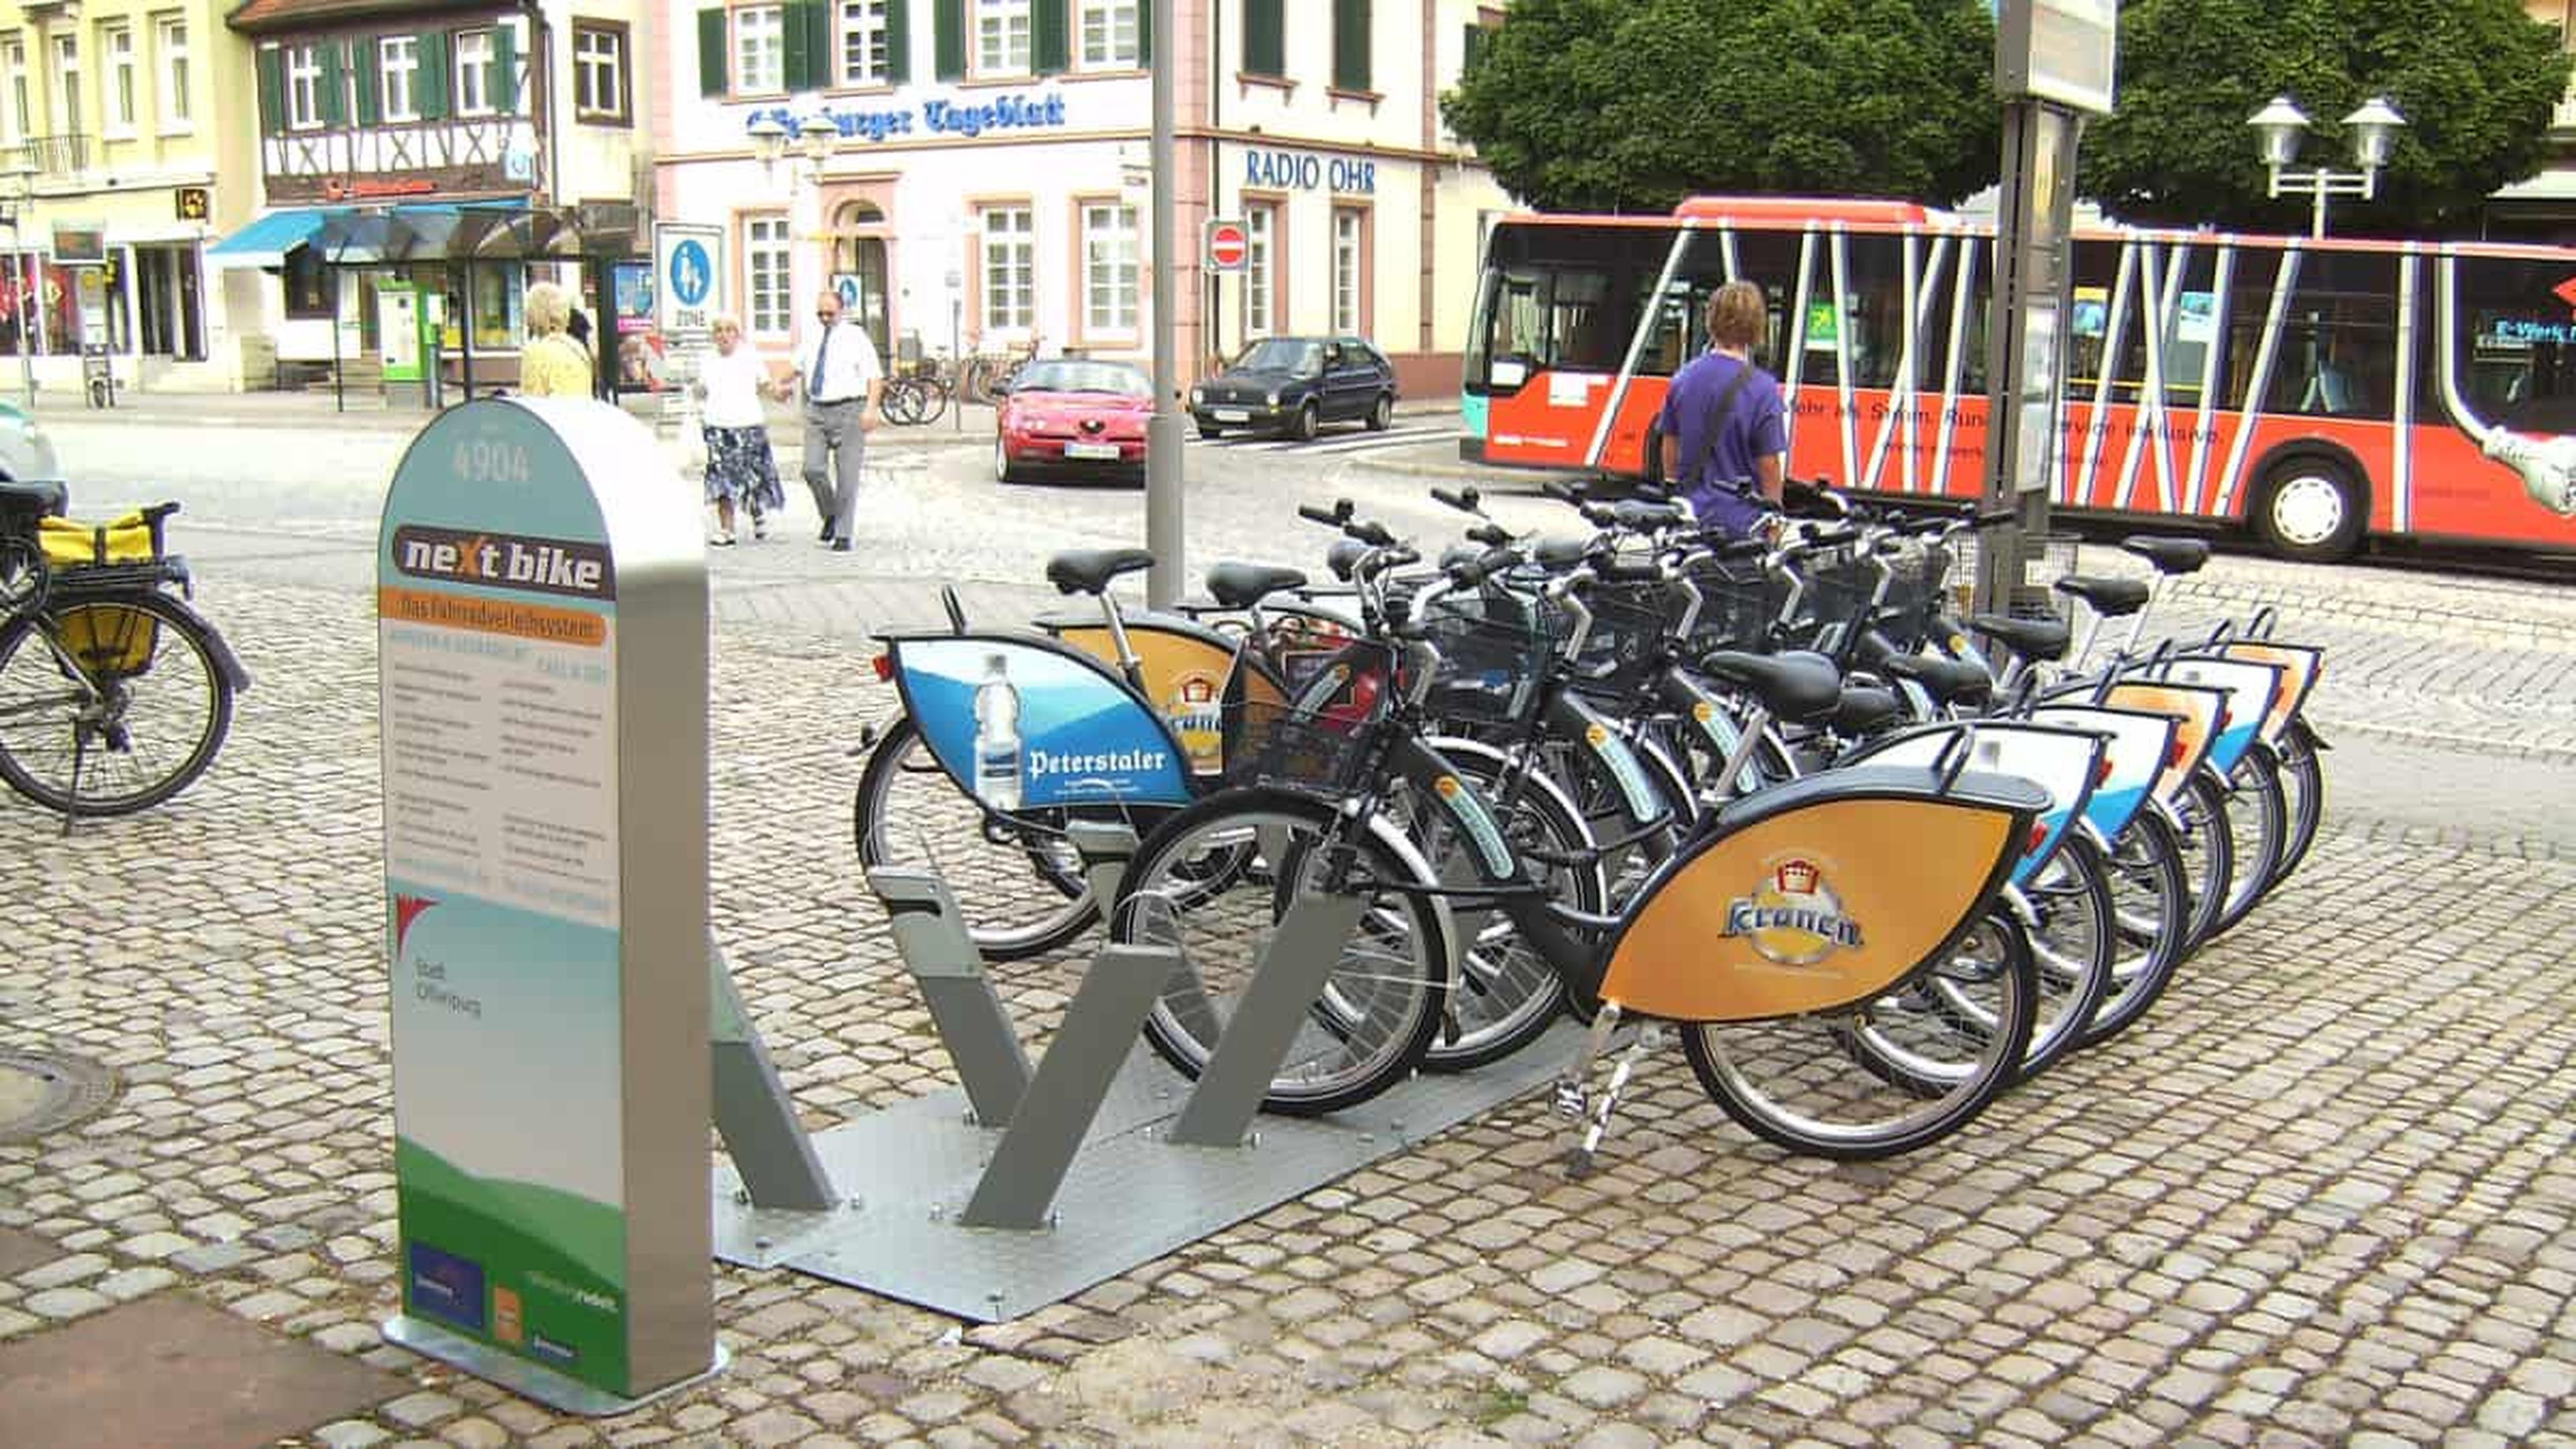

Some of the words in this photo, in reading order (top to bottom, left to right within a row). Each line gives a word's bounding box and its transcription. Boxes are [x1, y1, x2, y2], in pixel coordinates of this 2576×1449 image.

[924, 94, 1066, 137] Tageblatt
[1247, 150, 1320, 190] RADIO
[1329, 158, 1375, 194] OHR
[676, 309, 706, 327] ZONE
[452, 440, 529, 482] 4904
[506, 542, 602, 590] bike
[1030, 749, 1165, 781] Peterstaler
